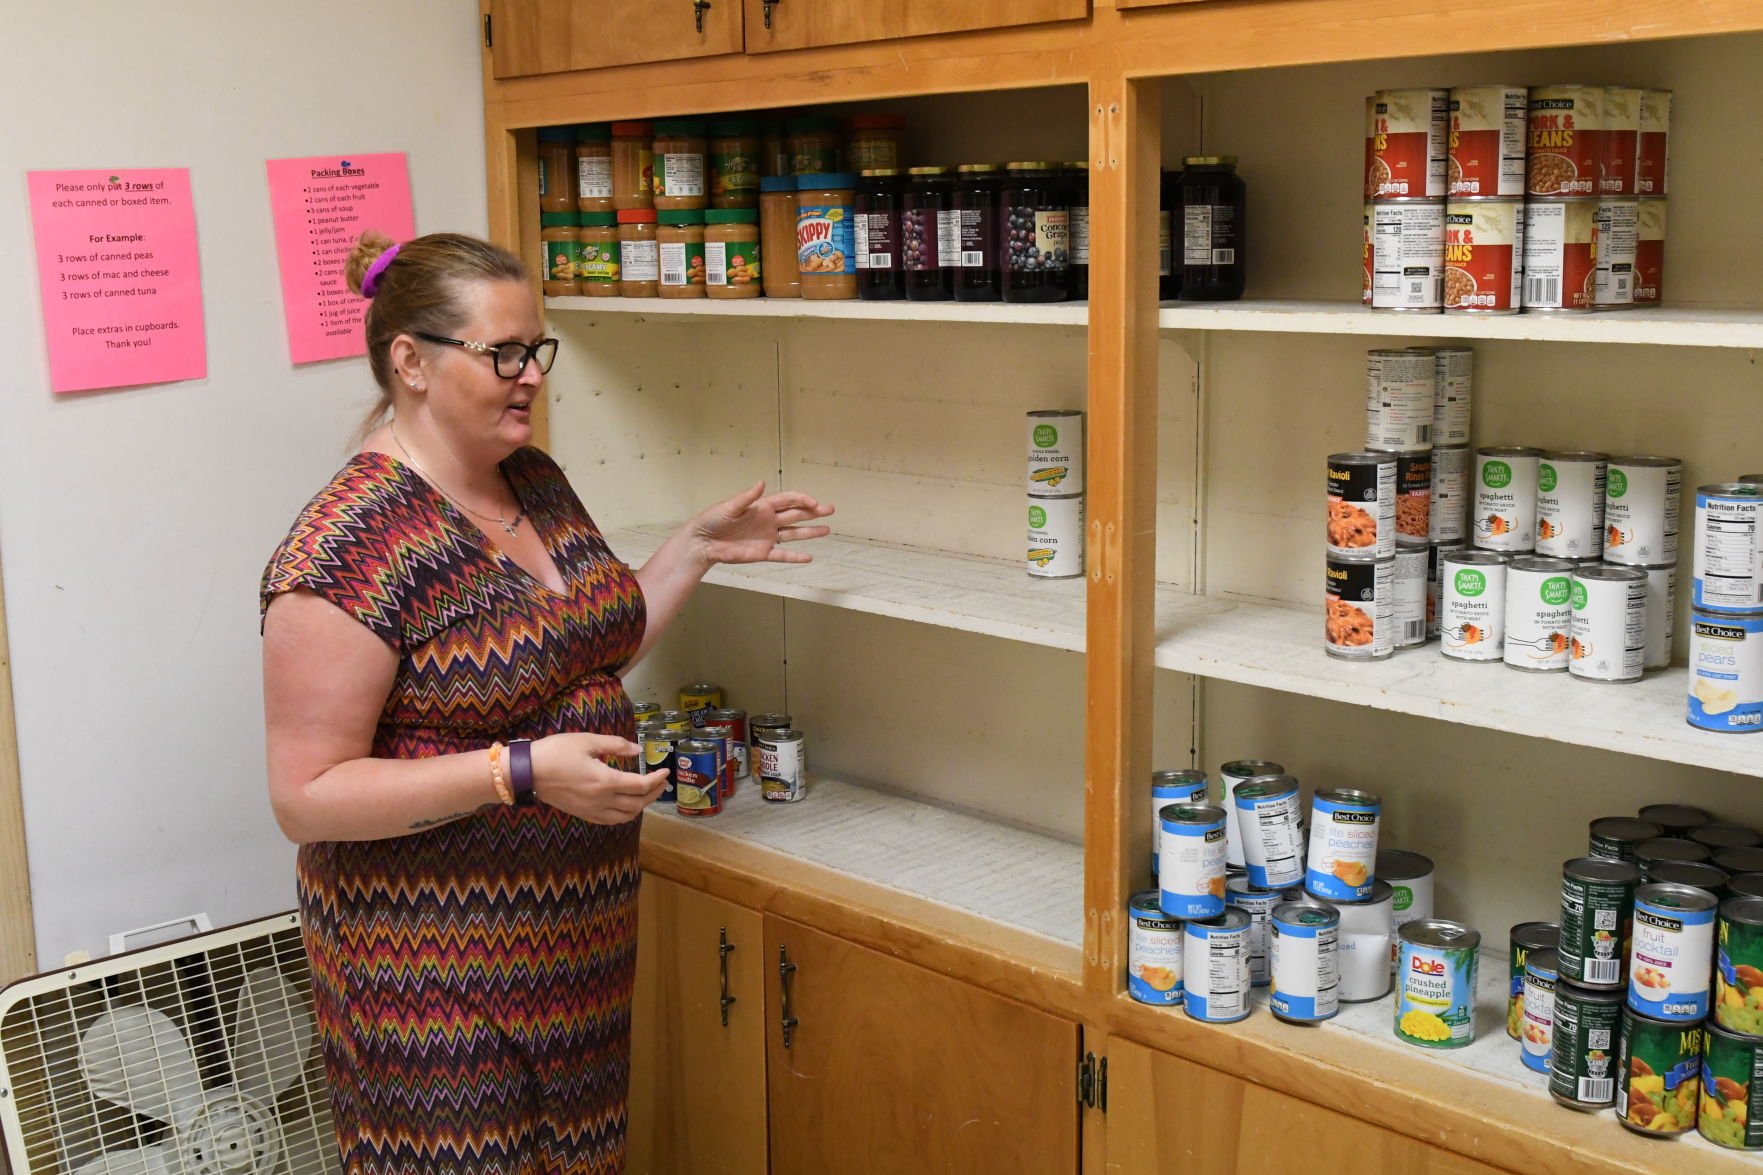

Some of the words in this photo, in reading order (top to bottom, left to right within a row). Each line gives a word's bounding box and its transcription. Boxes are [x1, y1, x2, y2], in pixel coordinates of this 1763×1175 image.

[1543, 100, 1572, 108] Choice
[1562, 114, 1575, 130] &
[311, 168, 340, 178] Packing
[342, 168, 365, 176] Boxes
[56, 183, 84, 192] Please
[86, 184, 105, 193] only
[108, 183, 122, 192] put
[125, 182, 130, 192] 3
[132, 183, 154, 192] rows
[155, 181, 164, 190] of
[350, 182, 380, 191] vegetable
[52, 199, 74, 208] each
[76, 198, 108, 207] canned
[121, 197, 148, 206] boxed
[150, 196, 172, 206] item.
[319, 227, 345, 235] jelly/jam
[1463, 229, 1473, 243] &
[89, 235, 104, 243] For
[106, 234, 146, 244] Example:
[58, 255, 64, 263] 3
[89, 253, 98, 262] of
[100, 252, 132, 261] canned
[134, 252, 154, 261] peas
[60, 273, 66, 282] 3
[91, 271, 100, 280] of
[122, 270, 138, 278] and
[141, 268, 169, 277] cheese
[62, 292, 68, 300] 3
[94, 289, 102, 298] of
[104, 288, 136, 297] canned
[138, 287, 157, 296] tuna
[72, 327, 94, 336] Place
[97, 325, 123, 334] extras
[125, 324, 133, 332] in
[135, 321, 180, 333] cupboards.
[326, 328, 352, 336] available
[105, 339, 131, 349] Thank
[133, 338, 152, 348] you!
[1329, 469, 1350, 480] Ravioli
[1480, 492, 1514, 501] spaghetti
[1707, 502, 1735, 512] Nutrition
[1327, 568, 1348, 580] Ravioli
[1458, 580, 1482, 592] SMART!
[1451, 601, 1488, 610] spaghetti
[1696, 624, 1710, 634] Best
[1711, 628, 1743, 638] Choice
[1698, 653, 1736, 666] pears
[1206, 831, 1220, 840] Best
[1329, 827, 1344, 837] lite
[1347, 829, 1375, 839] sliced
[1328, 839, 1374, 848] peaches
[1574, 904, 1583, 912] 70
[1636, 911, 1648, 922] Best
[1649, 916, 1680, 929] Choice
[1150, 936, 1182, 946] sliced
[1643, 928, 1664, 943] fruit
[1136, 944, 1181, 955] peaches
[1634, 938, 1679, 957] cocktail
[1412, 956, 1445, 974] Dole
[1409, 976, 1447, 989] crushed
[1532, 976, 1555, 990] Choice
[1406, 984, 1451, 999] pineapple
[1528, 989, 1544, 1002] fruit
